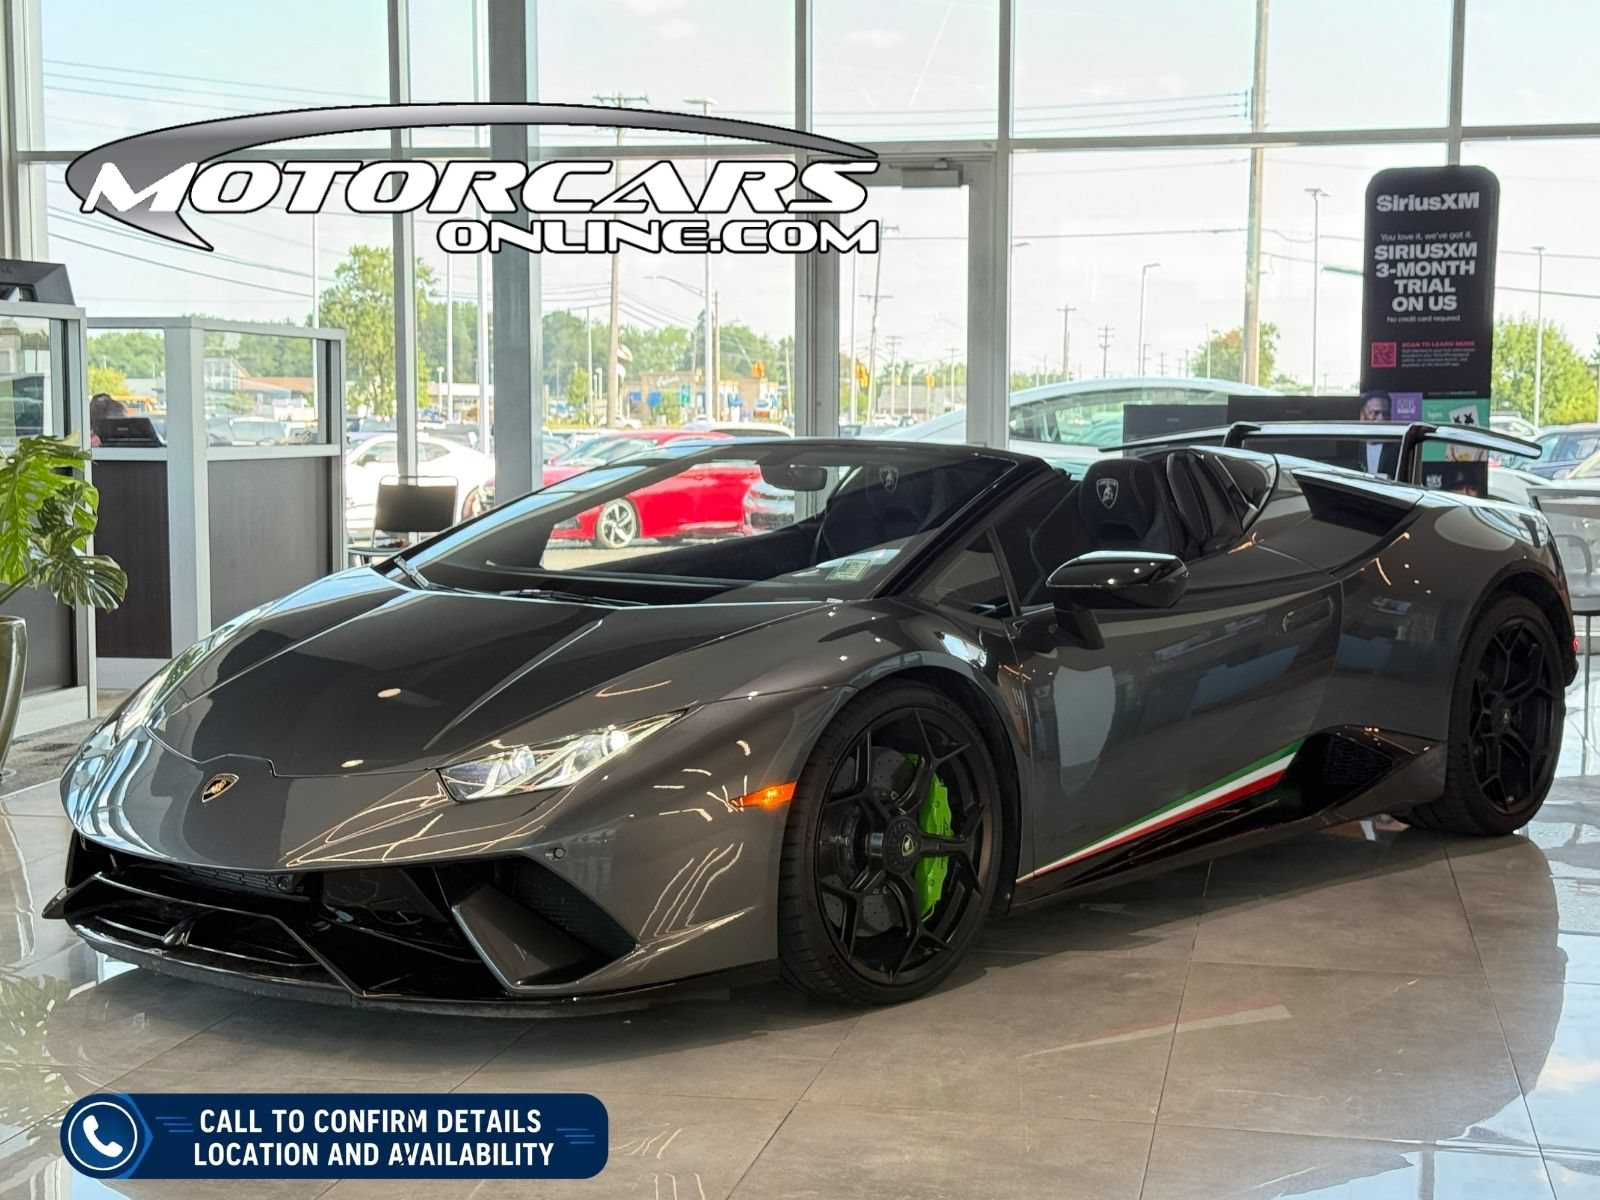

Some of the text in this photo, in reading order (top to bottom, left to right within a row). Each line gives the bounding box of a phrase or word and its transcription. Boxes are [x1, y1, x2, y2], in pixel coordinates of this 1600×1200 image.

[1376, 192, 1479, 212] SiriusXM
[1380, 233, 1396, 242] You
[1397, 232, 1414, 241] love
[1424, 231, 1448, 240] we've
[1449, 231, 1464, 241] got
[1374, 242, 1478, 261] SIRIUSXM
[1375, 260, 1476, 278] 3-MONTH
[1394, 278, 1456, 295] TRIAL
[1391, 295, 1457, 313] ON US
